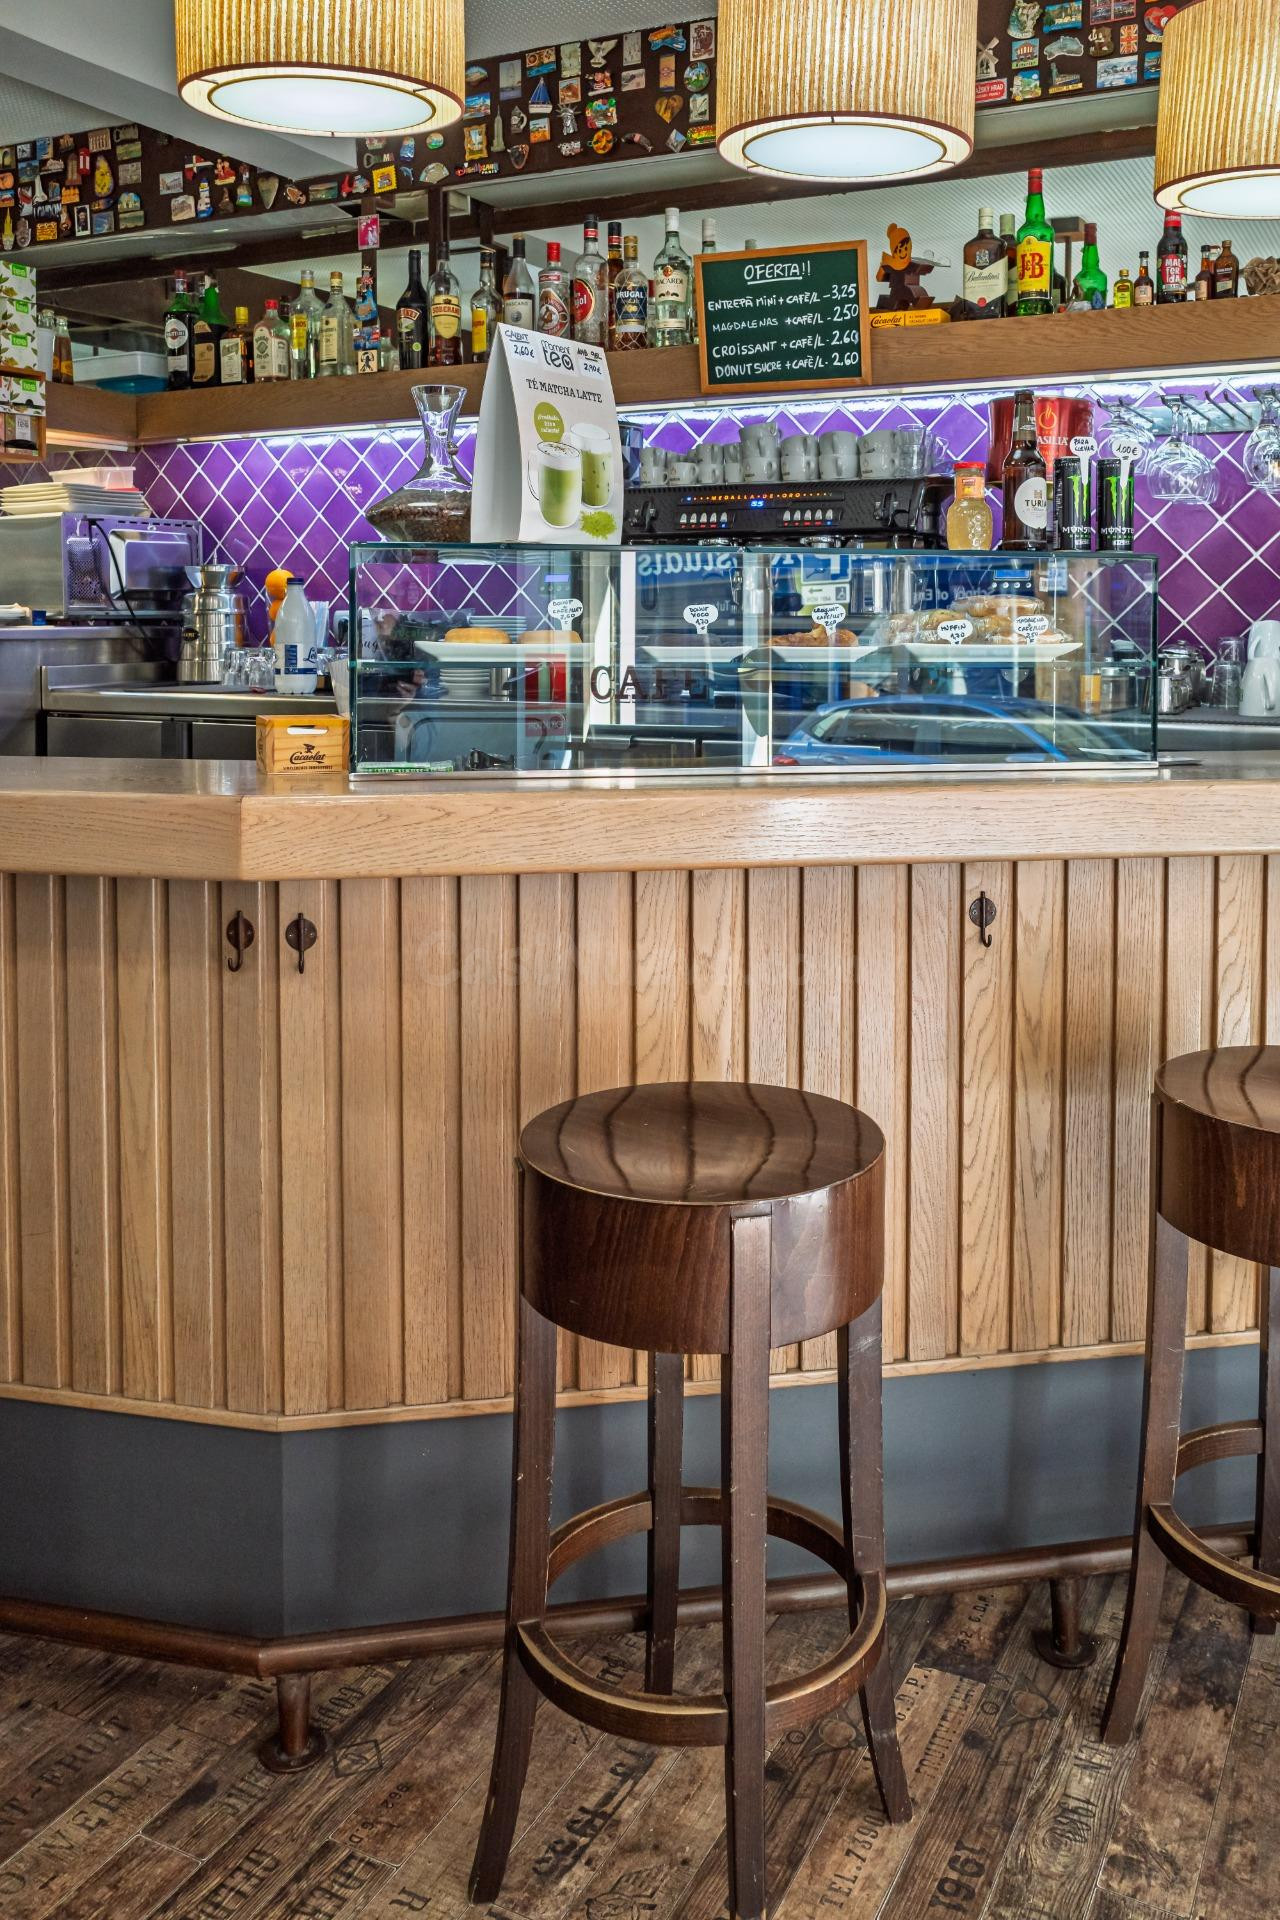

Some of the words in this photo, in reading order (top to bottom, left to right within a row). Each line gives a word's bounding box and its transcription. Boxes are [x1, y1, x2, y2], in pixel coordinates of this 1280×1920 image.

[526, 378, 539, 390] TÉ
[539, 381, 576, 398] MATCHA
[576, 389, 603, 403] LATTE
[1037, 436, 1069, 446] ASILIA
[289, 751, 326, 765] Cacaolat
